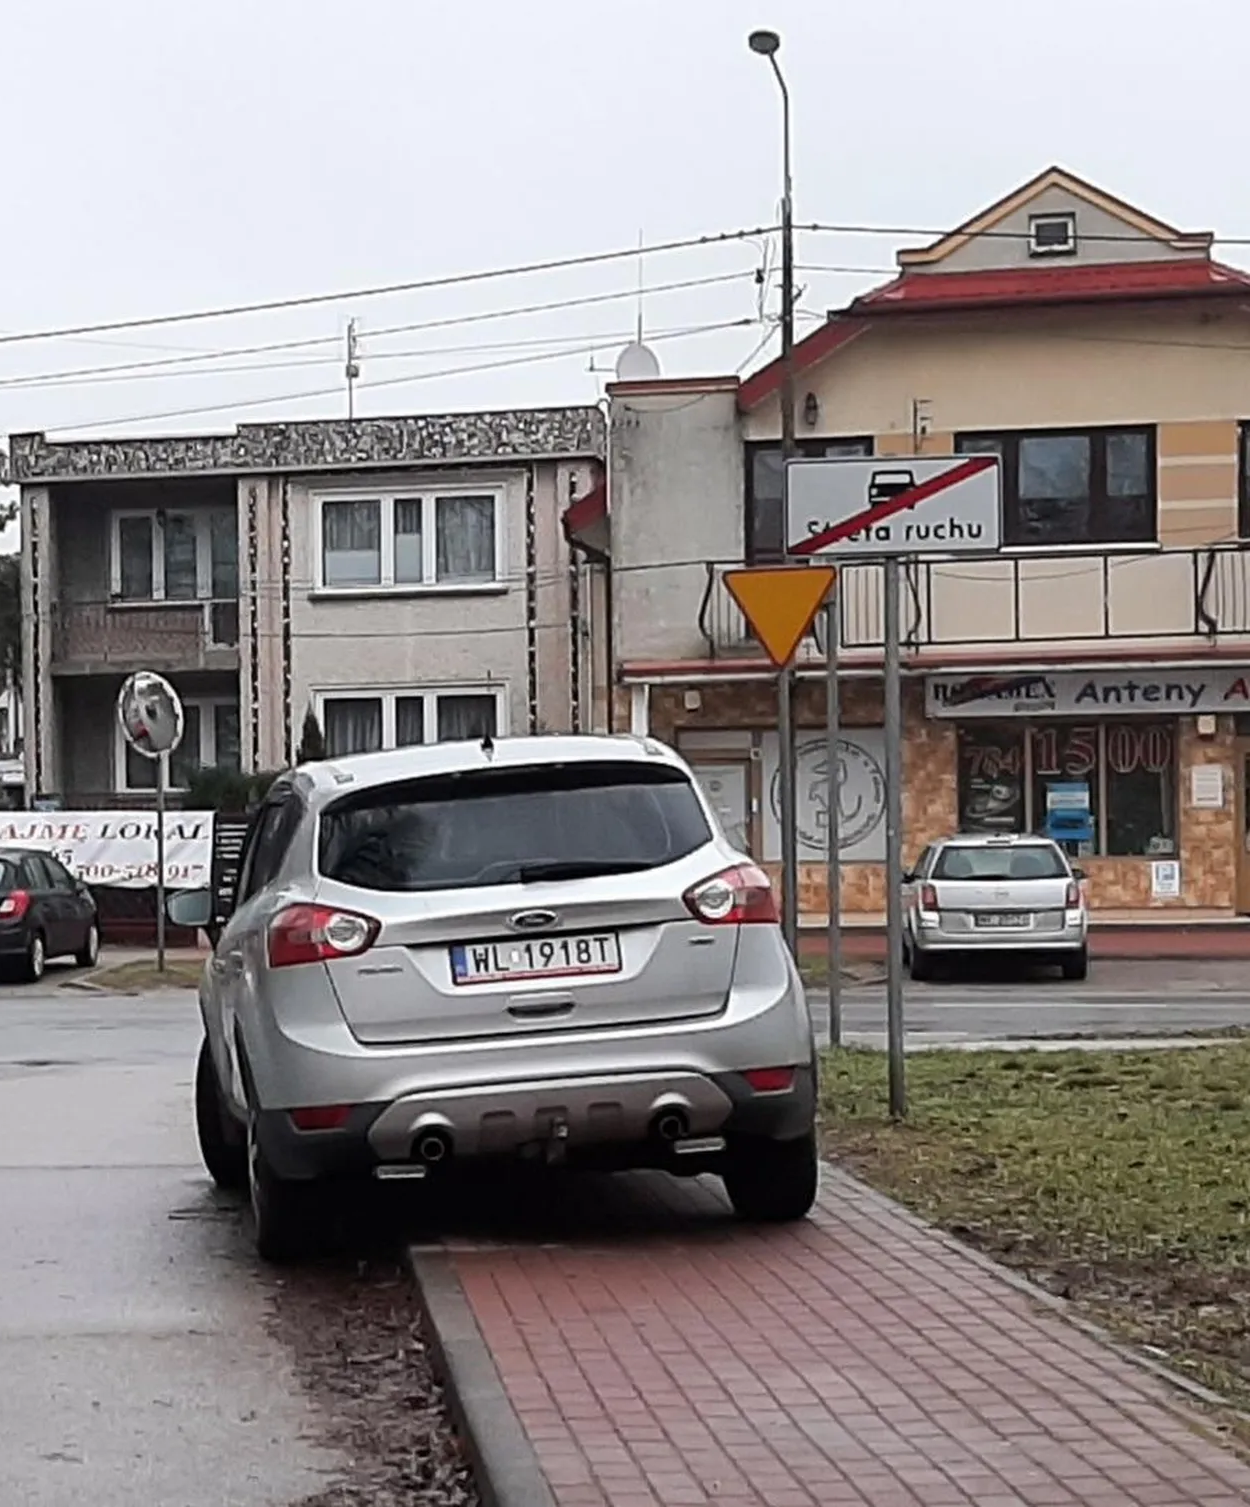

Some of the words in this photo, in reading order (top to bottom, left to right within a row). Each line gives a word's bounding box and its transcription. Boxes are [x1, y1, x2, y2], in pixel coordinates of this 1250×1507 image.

[905, 517, 982, 541] ruchu
[1074, 680, 1206, 708] Anteny
[472, 944, 510, 973] WL
[524, 937, 609, 969] 1918T
